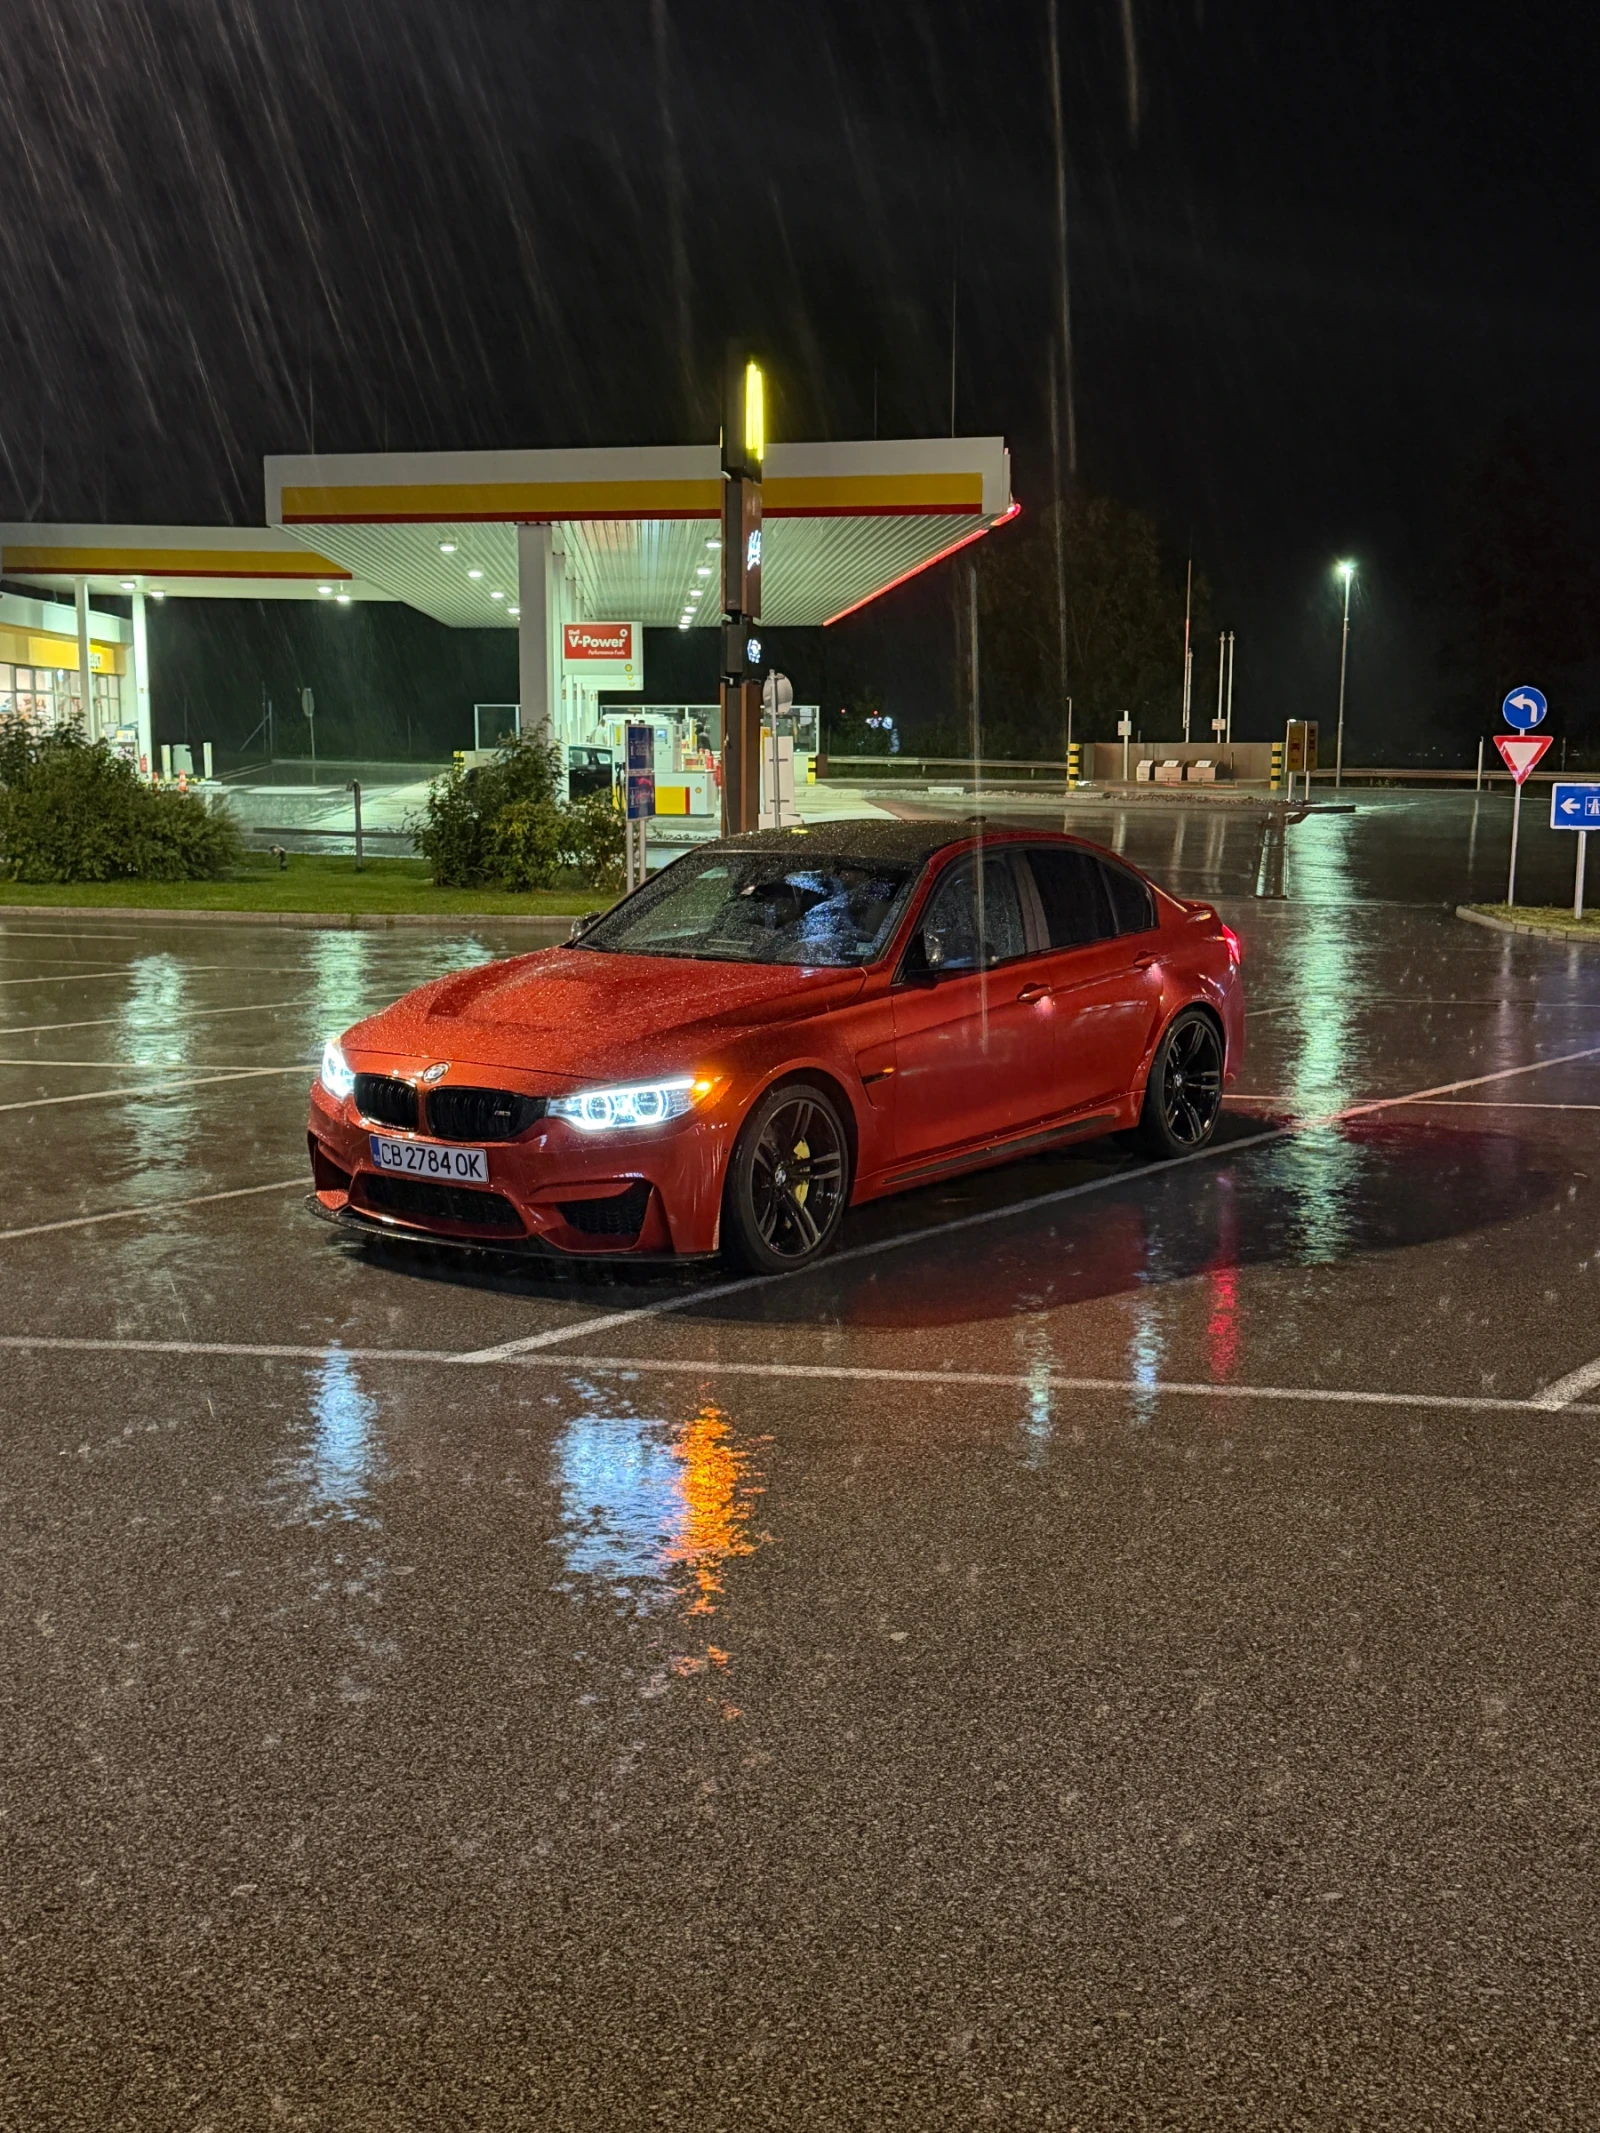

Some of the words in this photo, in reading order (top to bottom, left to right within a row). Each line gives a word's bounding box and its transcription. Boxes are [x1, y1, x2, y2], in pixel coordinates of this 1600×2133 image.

[568, 635, 625, 648] V-Power
[381, 1143, 403, 1167] CB
[405, 1146, 452, 1175] 2784
[455, 1153, 482, 1179] OK
